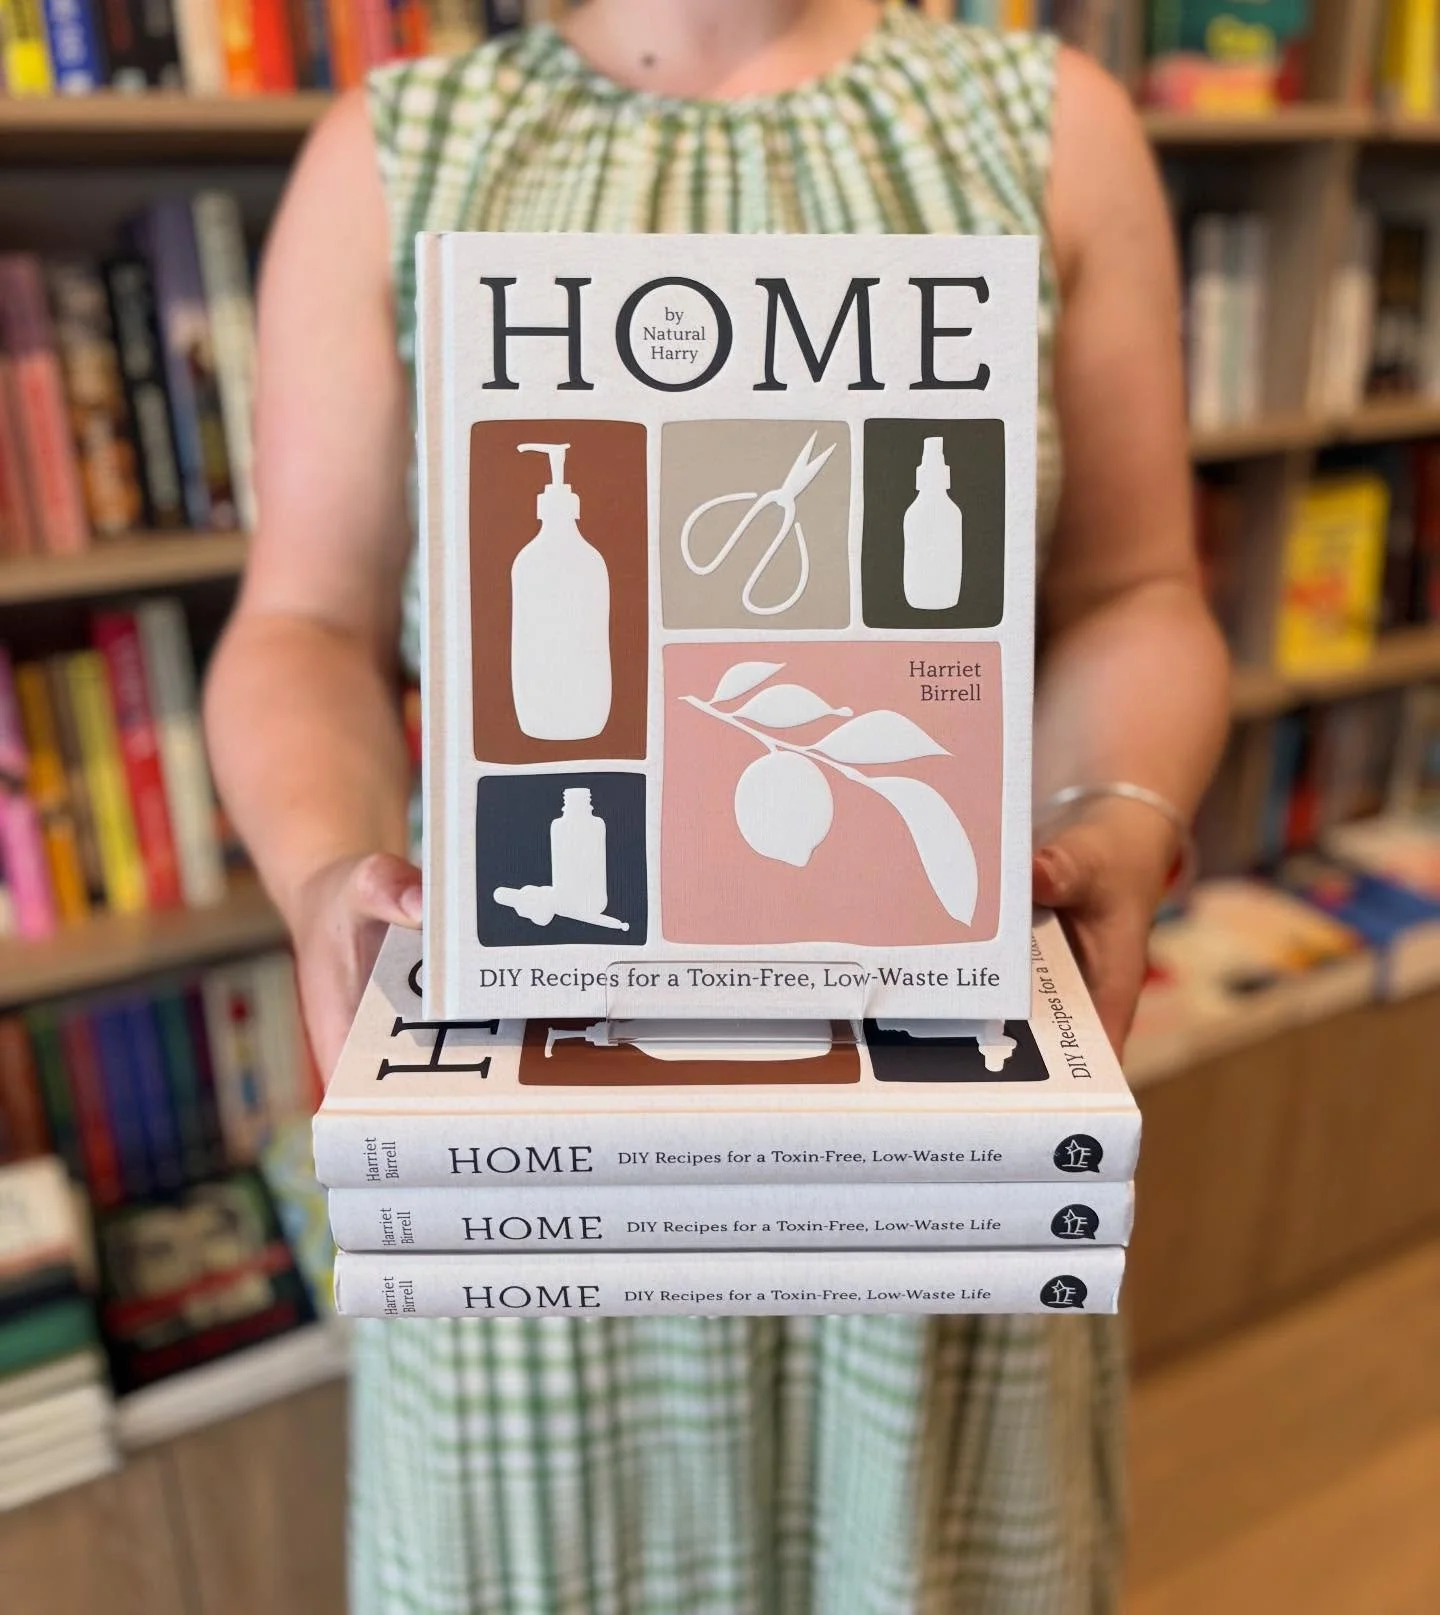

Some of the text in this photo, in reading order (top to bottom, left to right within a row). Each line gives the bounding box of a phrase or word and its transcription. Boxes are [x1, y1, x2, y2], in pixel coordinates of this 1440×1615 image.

[664, 306, 685, 326] by
[479, 275, 991, 393] HOME
[643, 325, 706, 341] Natural
[651, 345, 699, 364] Harry
[909, 660, 982, 678] Harriet
[920, 683, 981, 702] Birrell
[479, 967, 1000, 992] DIY Recipes for a Toxin-Free, Low-Waste Life
[1036, 966, 1049, 975] a
[1038, 976, 1058, 996] for
[1048, 997, 1080, 1049] Recipes
[1063, 1052, 1092, 1079] DIY
[364, 1136, 382, 1183] Harriet
[381, 1141, 400, 1179] Birrell
[447, 1145, 593, 1174] HOME
[618, 1149, 1003, 1167] DIY Recipes for a Toxin-Free, Low-Waste Life
[379, 1206, 397, 1248] Harriet
[396, 1211, 415, 1245] Birrell
[461, 1215, 603, 1241] HOME
[627, 1218, 1001, 1235] DIY Recipes for a Toxin-Free, Low-Waste Life
[381, 1275, 399, 1316] Harriet
[398, 1280, 417, 1313] Birrell
[462, 1285, 601, 1309] HOME
[624, 1288, 991, 1304] DIY Recipes for a Toxin-Free, Low-Waste Life
